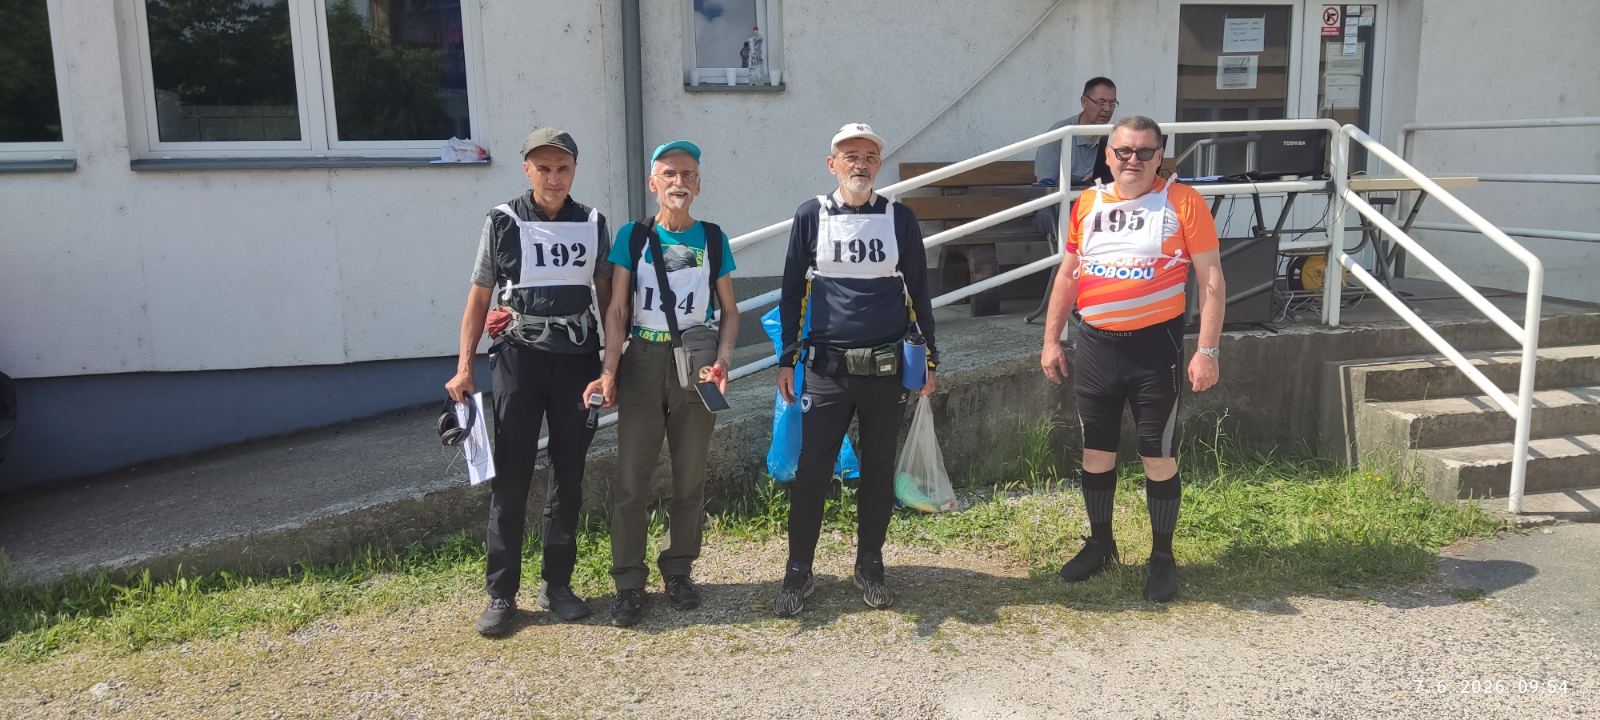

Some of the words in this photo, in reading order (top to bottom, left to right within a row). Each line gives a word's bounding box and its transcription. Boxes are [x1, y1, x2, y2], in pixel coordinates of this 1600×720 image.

[1092, 209, 1145, 233] 195
[533, 242, 587, 267] 192
[832, 238, 887, 264] 198
[642, 286, 695, 315] 14
[639, 330, 655, 342] LOS
